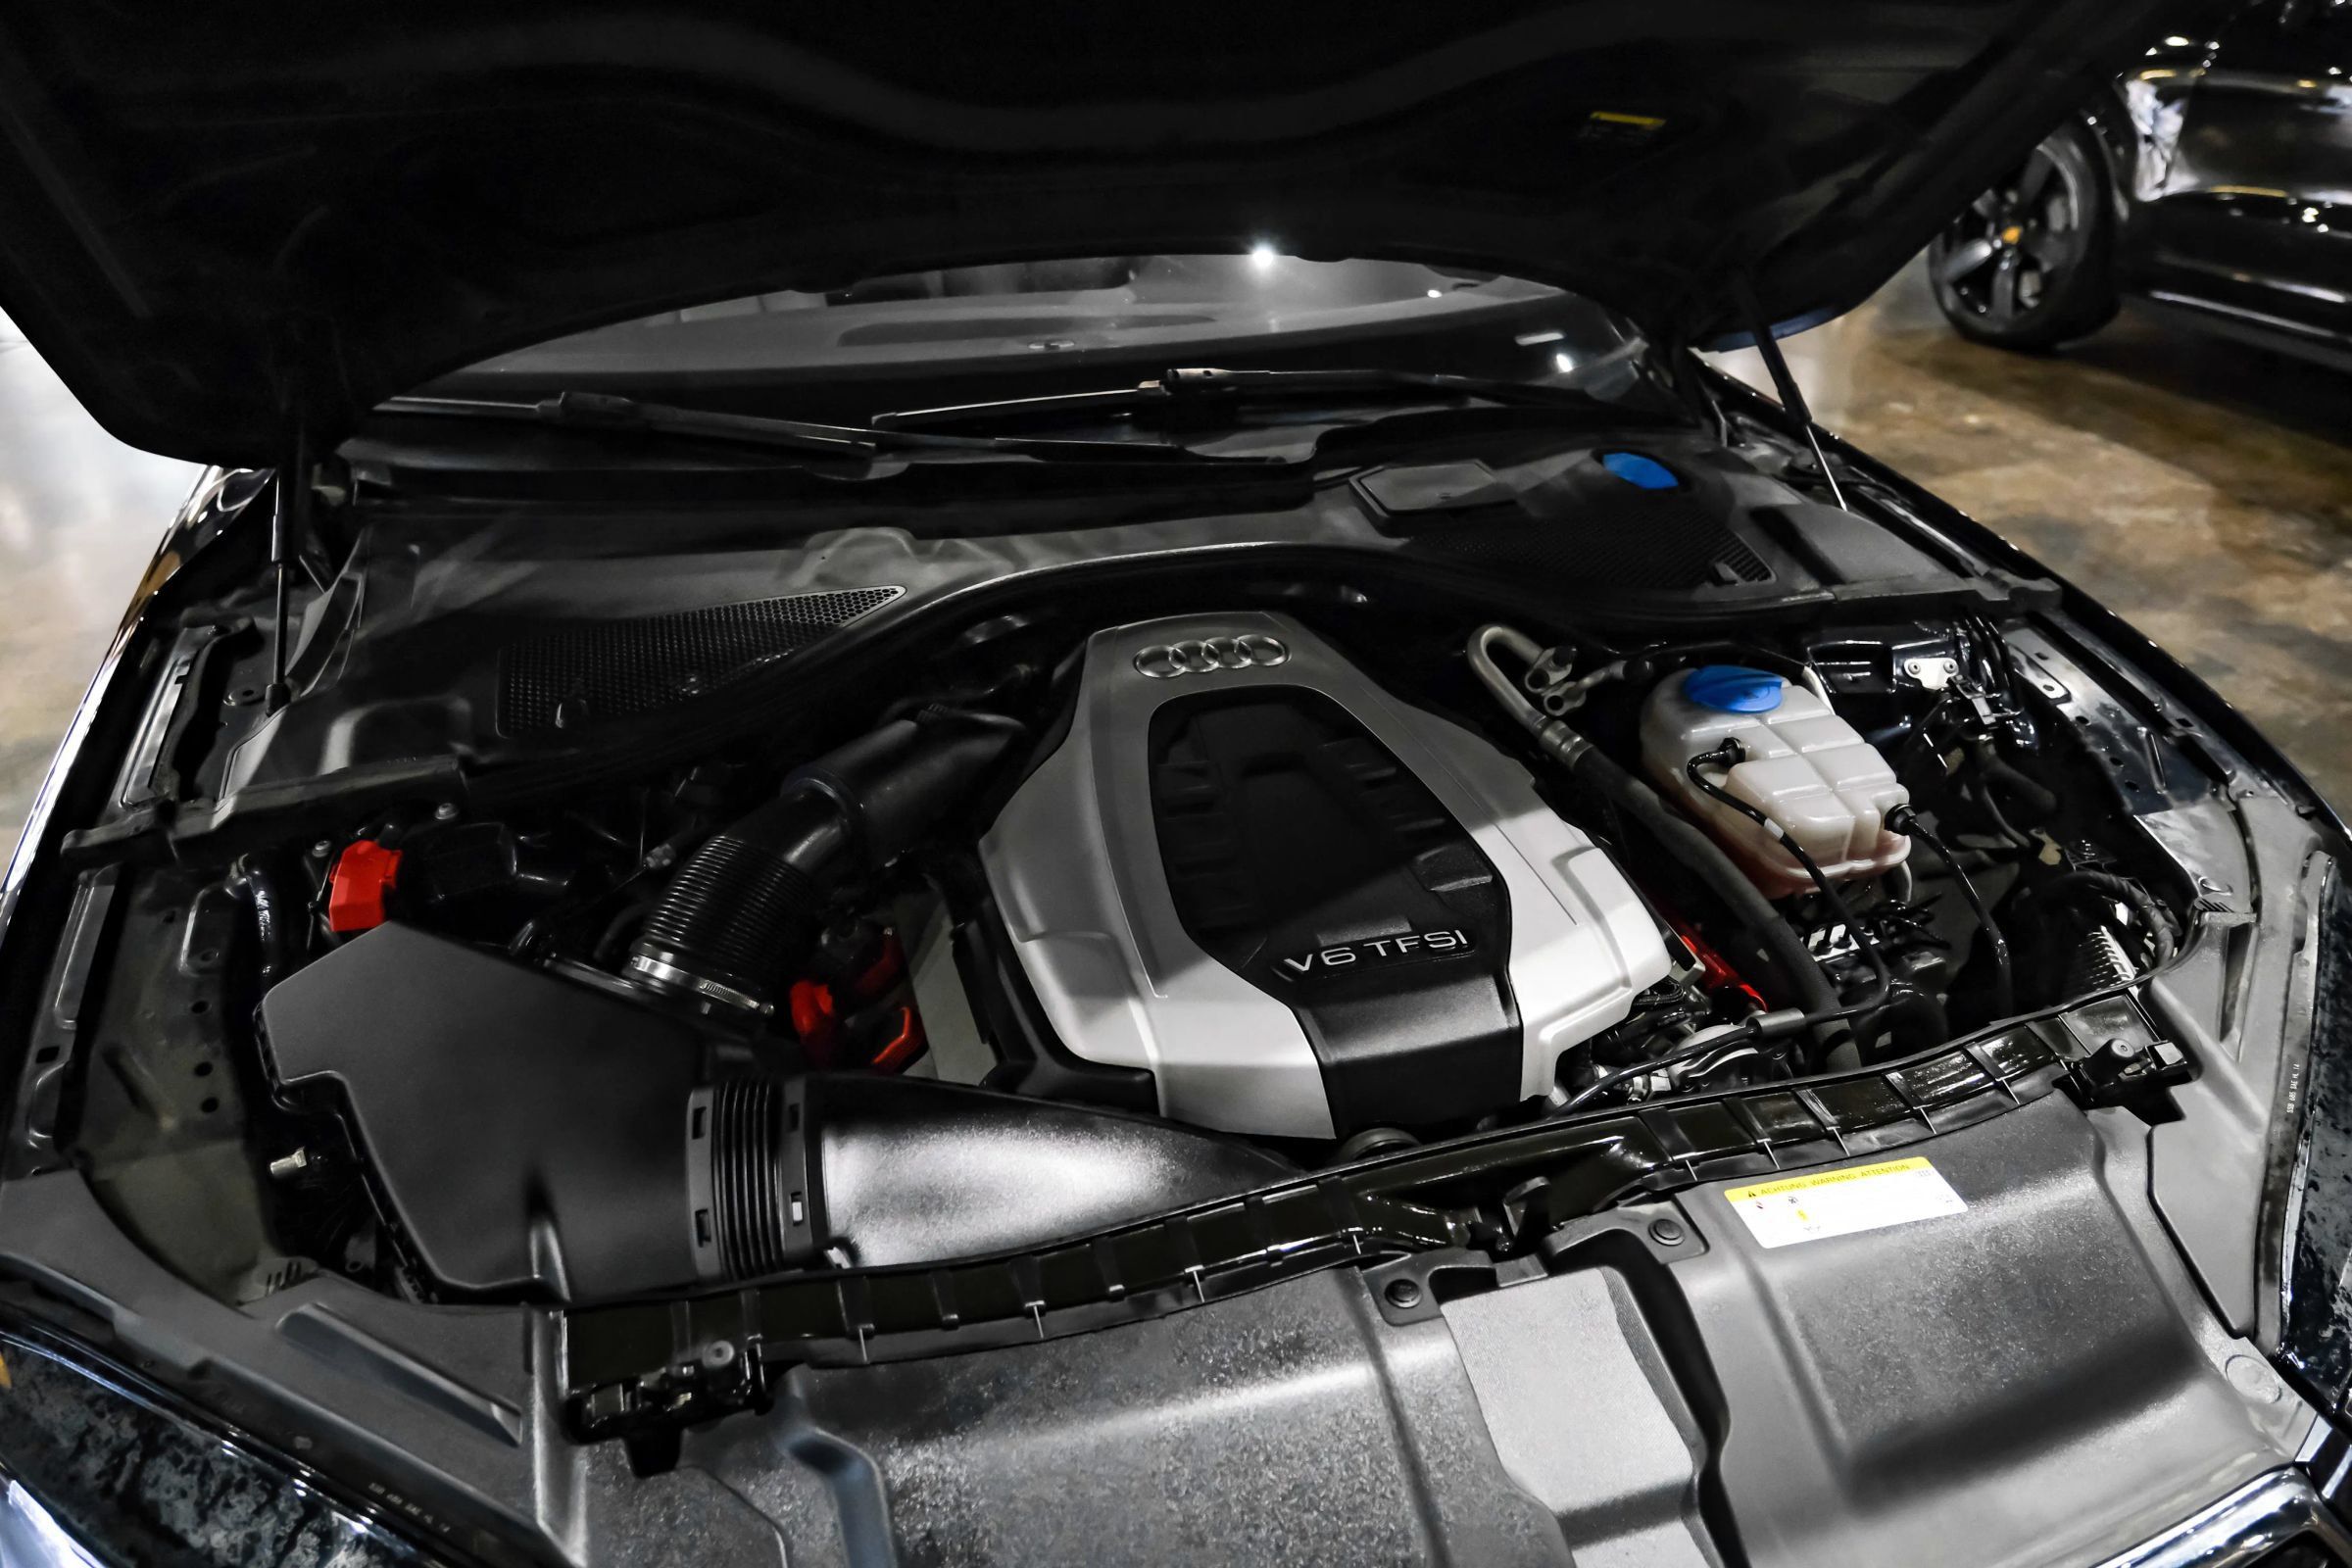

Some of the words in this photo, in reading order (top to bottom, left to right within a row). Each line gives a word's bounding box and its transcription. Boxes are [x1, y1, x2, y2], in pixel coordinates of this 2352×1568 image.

[1284, 947, 1356, 972] V6
[1363, 929, 1468, 957] TFSI
[1760, 1182, 1807, 1196] ACHTUNG
[1811, 1173, 1857, 1187] WARNING
[1860, 1163, 1911, 1178] ATTENTION
